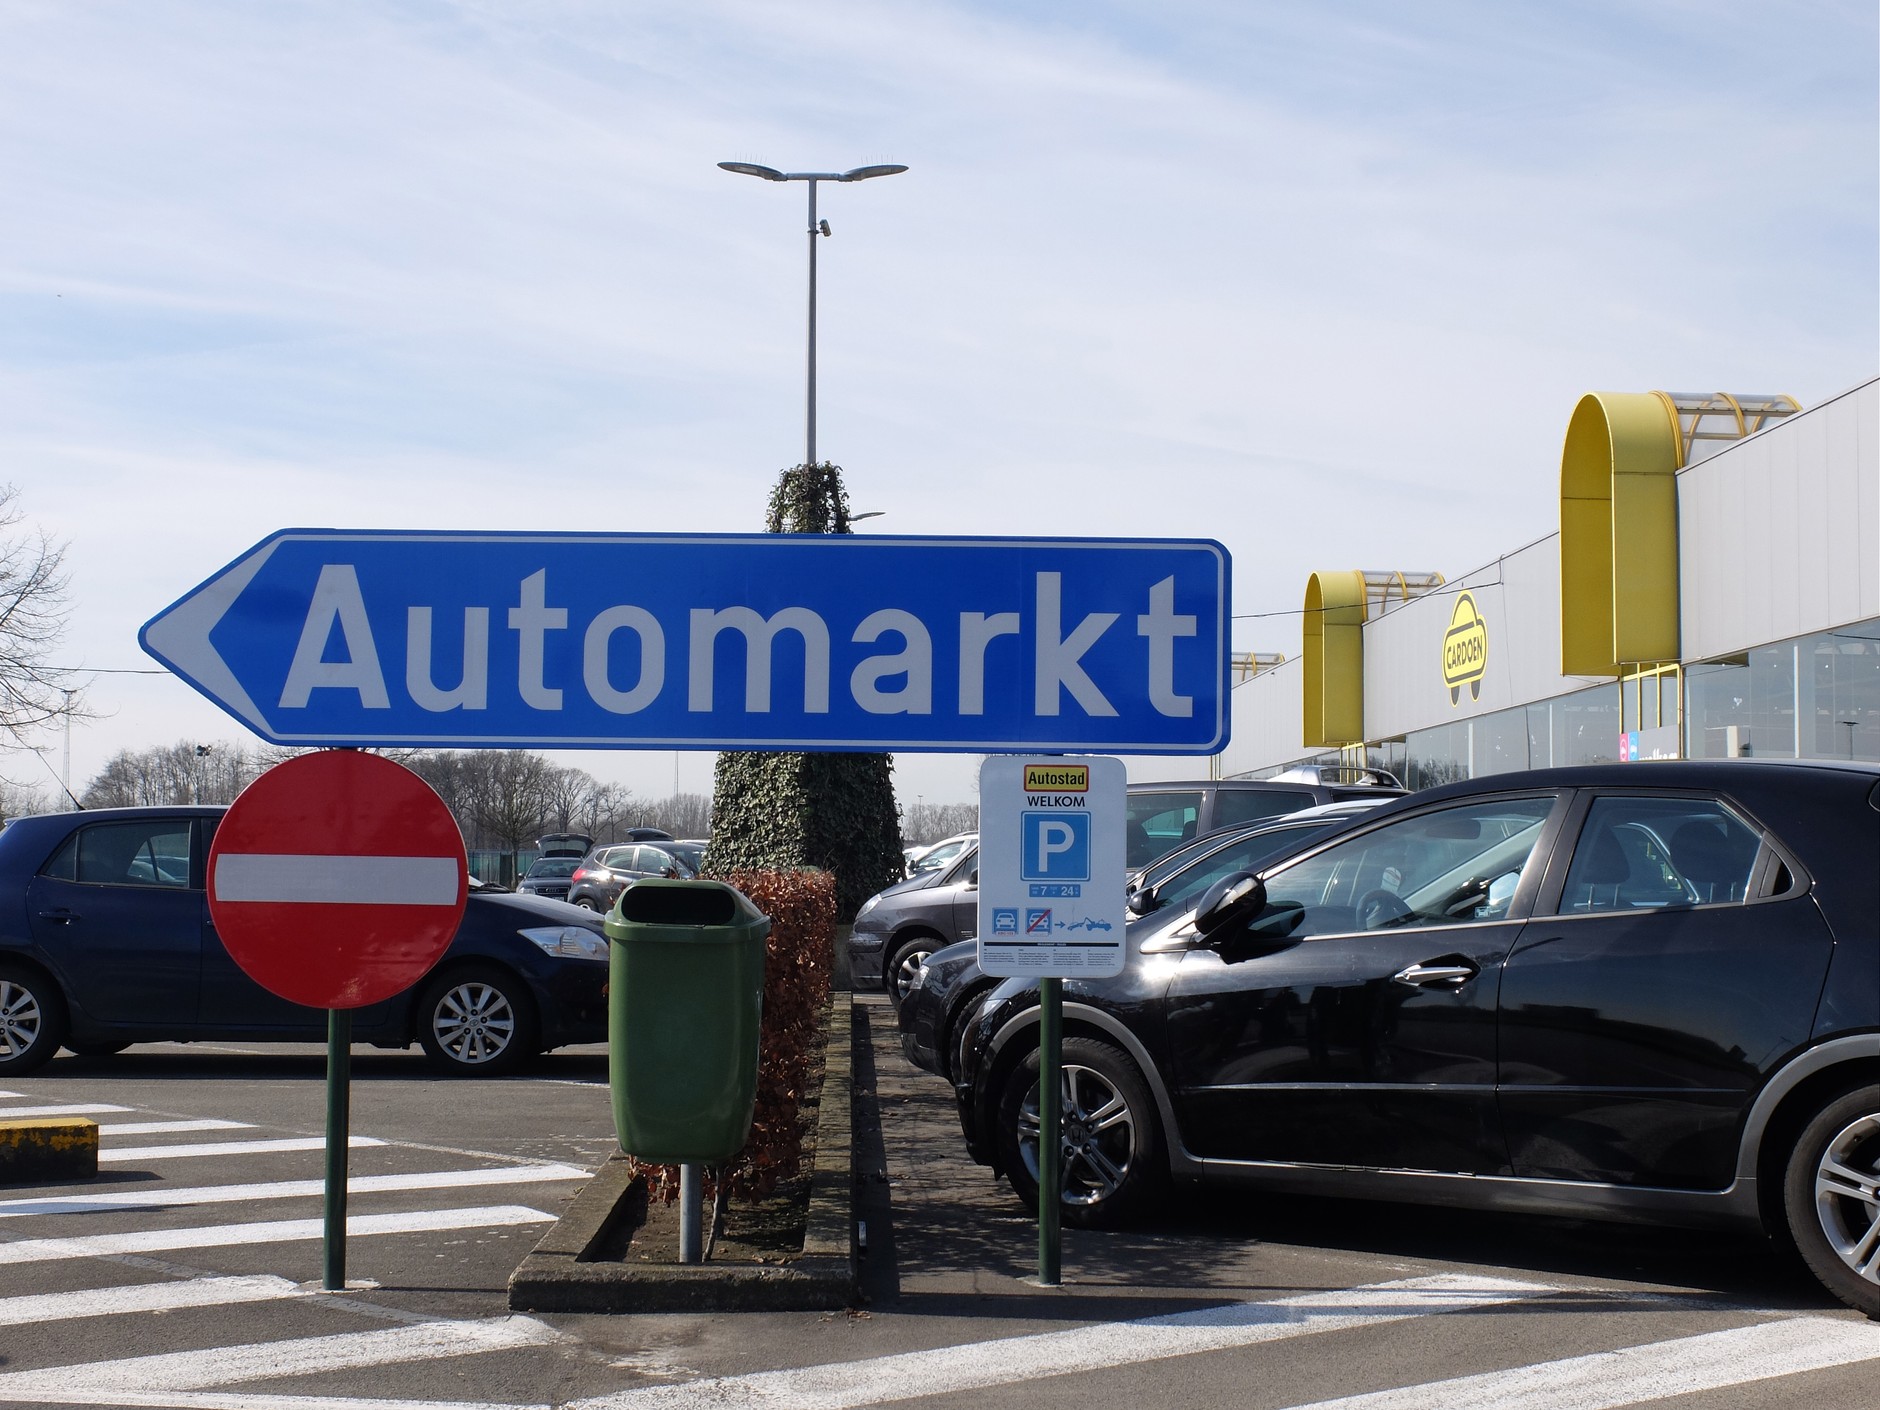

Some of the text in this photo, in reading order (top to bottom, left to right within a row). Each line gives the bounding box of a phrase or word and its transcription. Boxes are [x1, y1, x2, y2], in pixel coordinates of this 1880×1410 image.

[277, 563, 1198, 718] Automarkt
[1446, 634, 1483, 670] CARDOEN
[1028, 771, 1085, 785] Autostad
[1027, 795, 1086, 808] WELKOM
[1038, 820, 1075, 873] P
[1040, 886, 1048, 896] 7
[1060, 886, 1074, 896] 24
